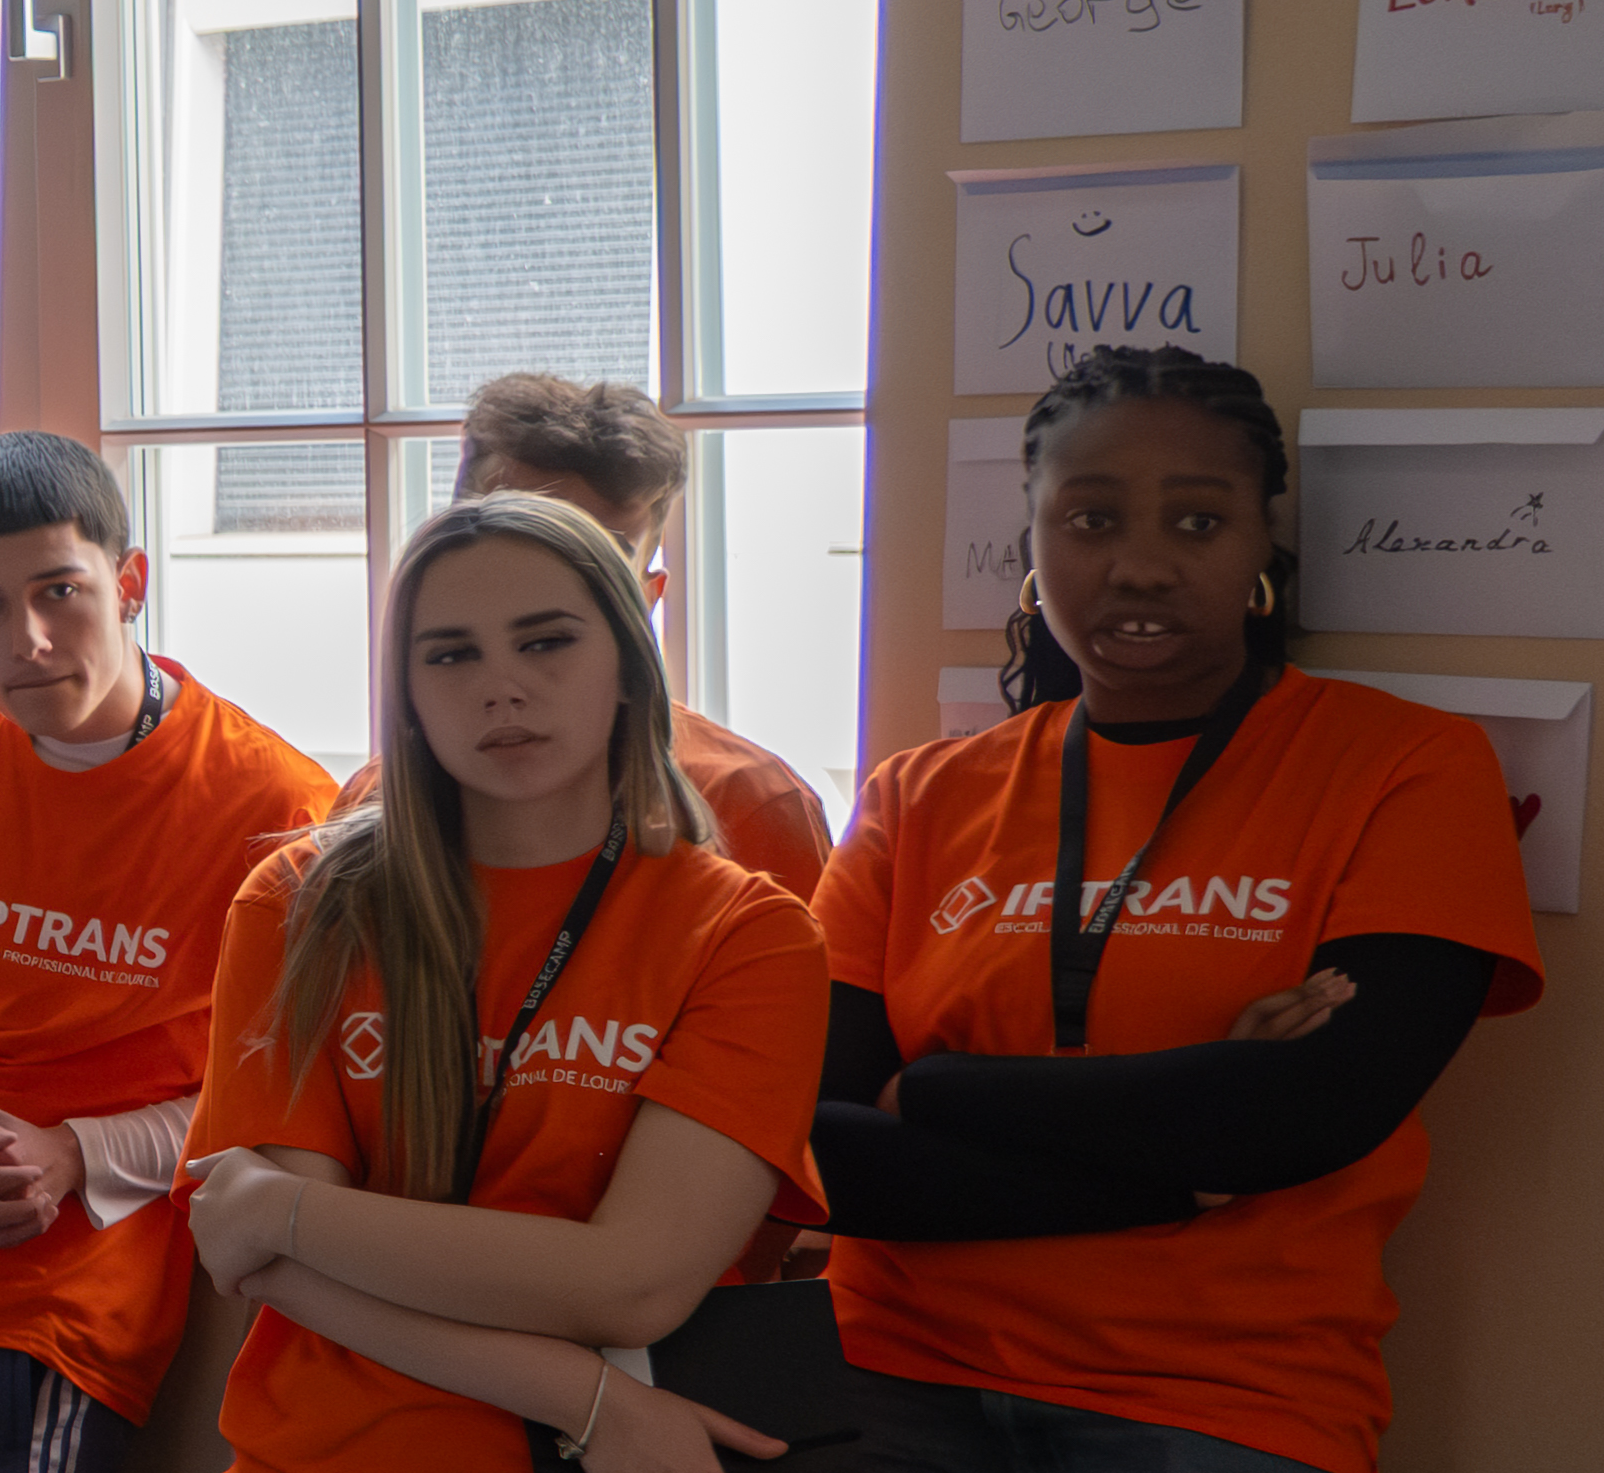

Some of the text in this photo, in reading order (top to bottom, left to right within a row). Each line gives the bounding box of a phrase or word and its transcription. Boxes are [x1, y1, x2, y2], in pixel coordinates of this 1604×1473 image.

[1341, 231, 1494, 291] Julia
[998, 233, 1202, 350] Savva
[1343, 517, 1553, 556] Alexandra
[994, 922, 1052, 935] ESCOL
[1184, 922, 1210, 937] DE
[552, 1068, 578, 1085] DE
[580, 1072, 632, 1094] LOUR
